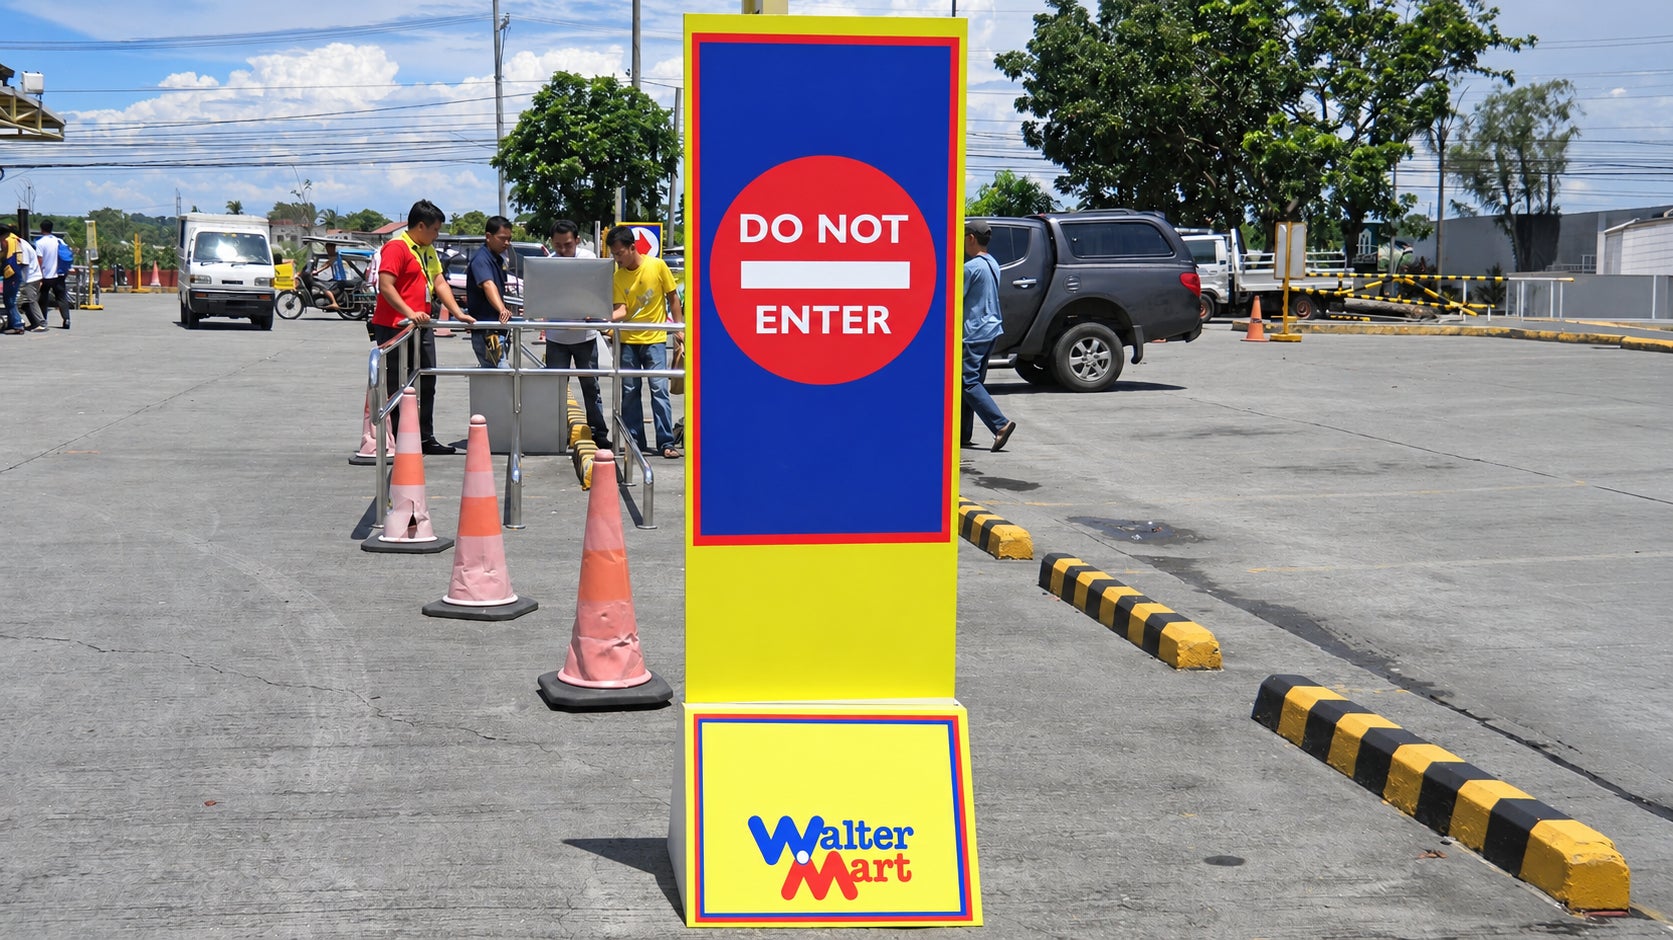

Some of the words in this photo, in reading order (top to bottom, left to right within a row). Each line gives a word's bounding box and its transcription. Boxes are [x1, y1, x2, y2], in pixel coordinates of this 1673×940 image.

[739, 213, 803, 244] DO
[818, 214, 909, 244] NOT
[755, 305, 892, 335] ENTER
[747, 815, 914, 866] Walter
[780, 850, 912, 901] Mart
